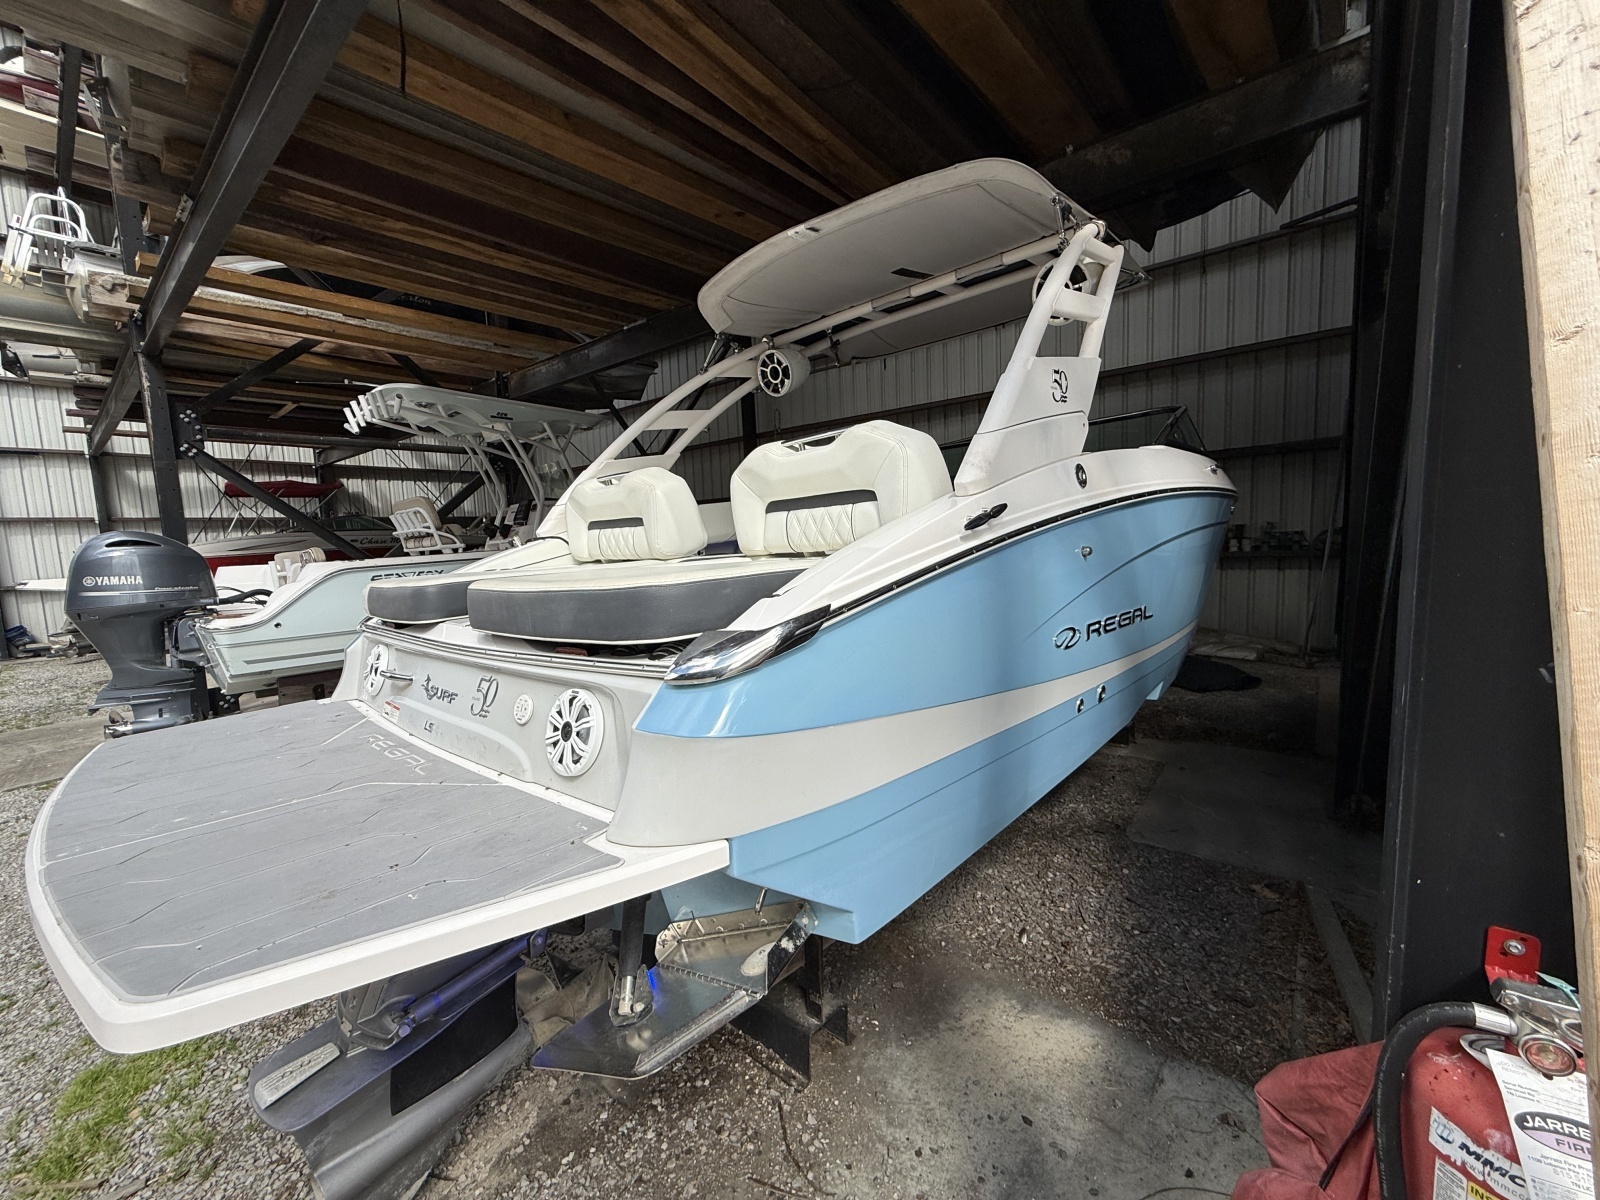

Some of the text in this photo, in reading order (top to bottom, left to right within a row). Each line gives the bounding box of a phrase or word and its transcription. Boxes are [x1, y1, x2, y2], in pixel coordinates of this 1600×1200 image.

[96, 575, 143, 586] YAMAHA
[1086, 606, 1153, 641] REGAL
[358, 733, 432, 775] REGAL
[1458, 1142, 1527, 1188] MMC
